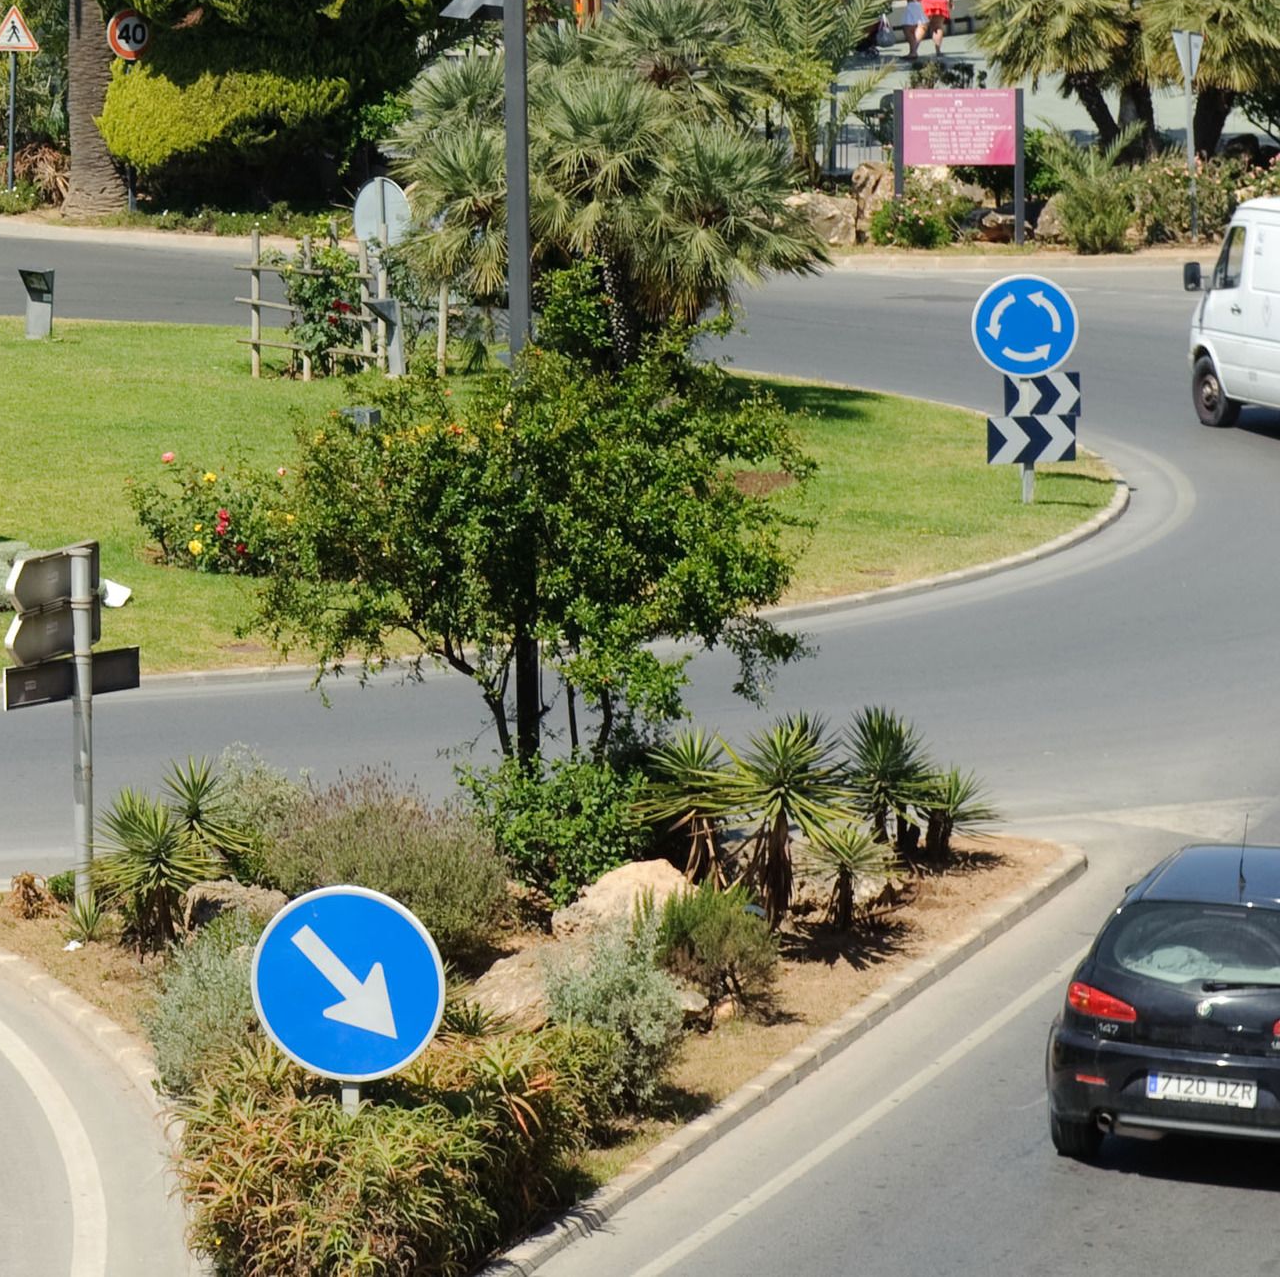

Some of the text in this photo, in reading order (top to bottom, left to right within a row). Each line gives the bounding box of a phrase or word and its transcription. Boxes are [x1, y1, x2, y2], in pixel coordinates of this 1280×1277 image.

[118, 23, 146, 45] 40
[1097, 1022, 1119, 1035] 147
[1161, 1074, 1253, 1100] 7120 DZR
